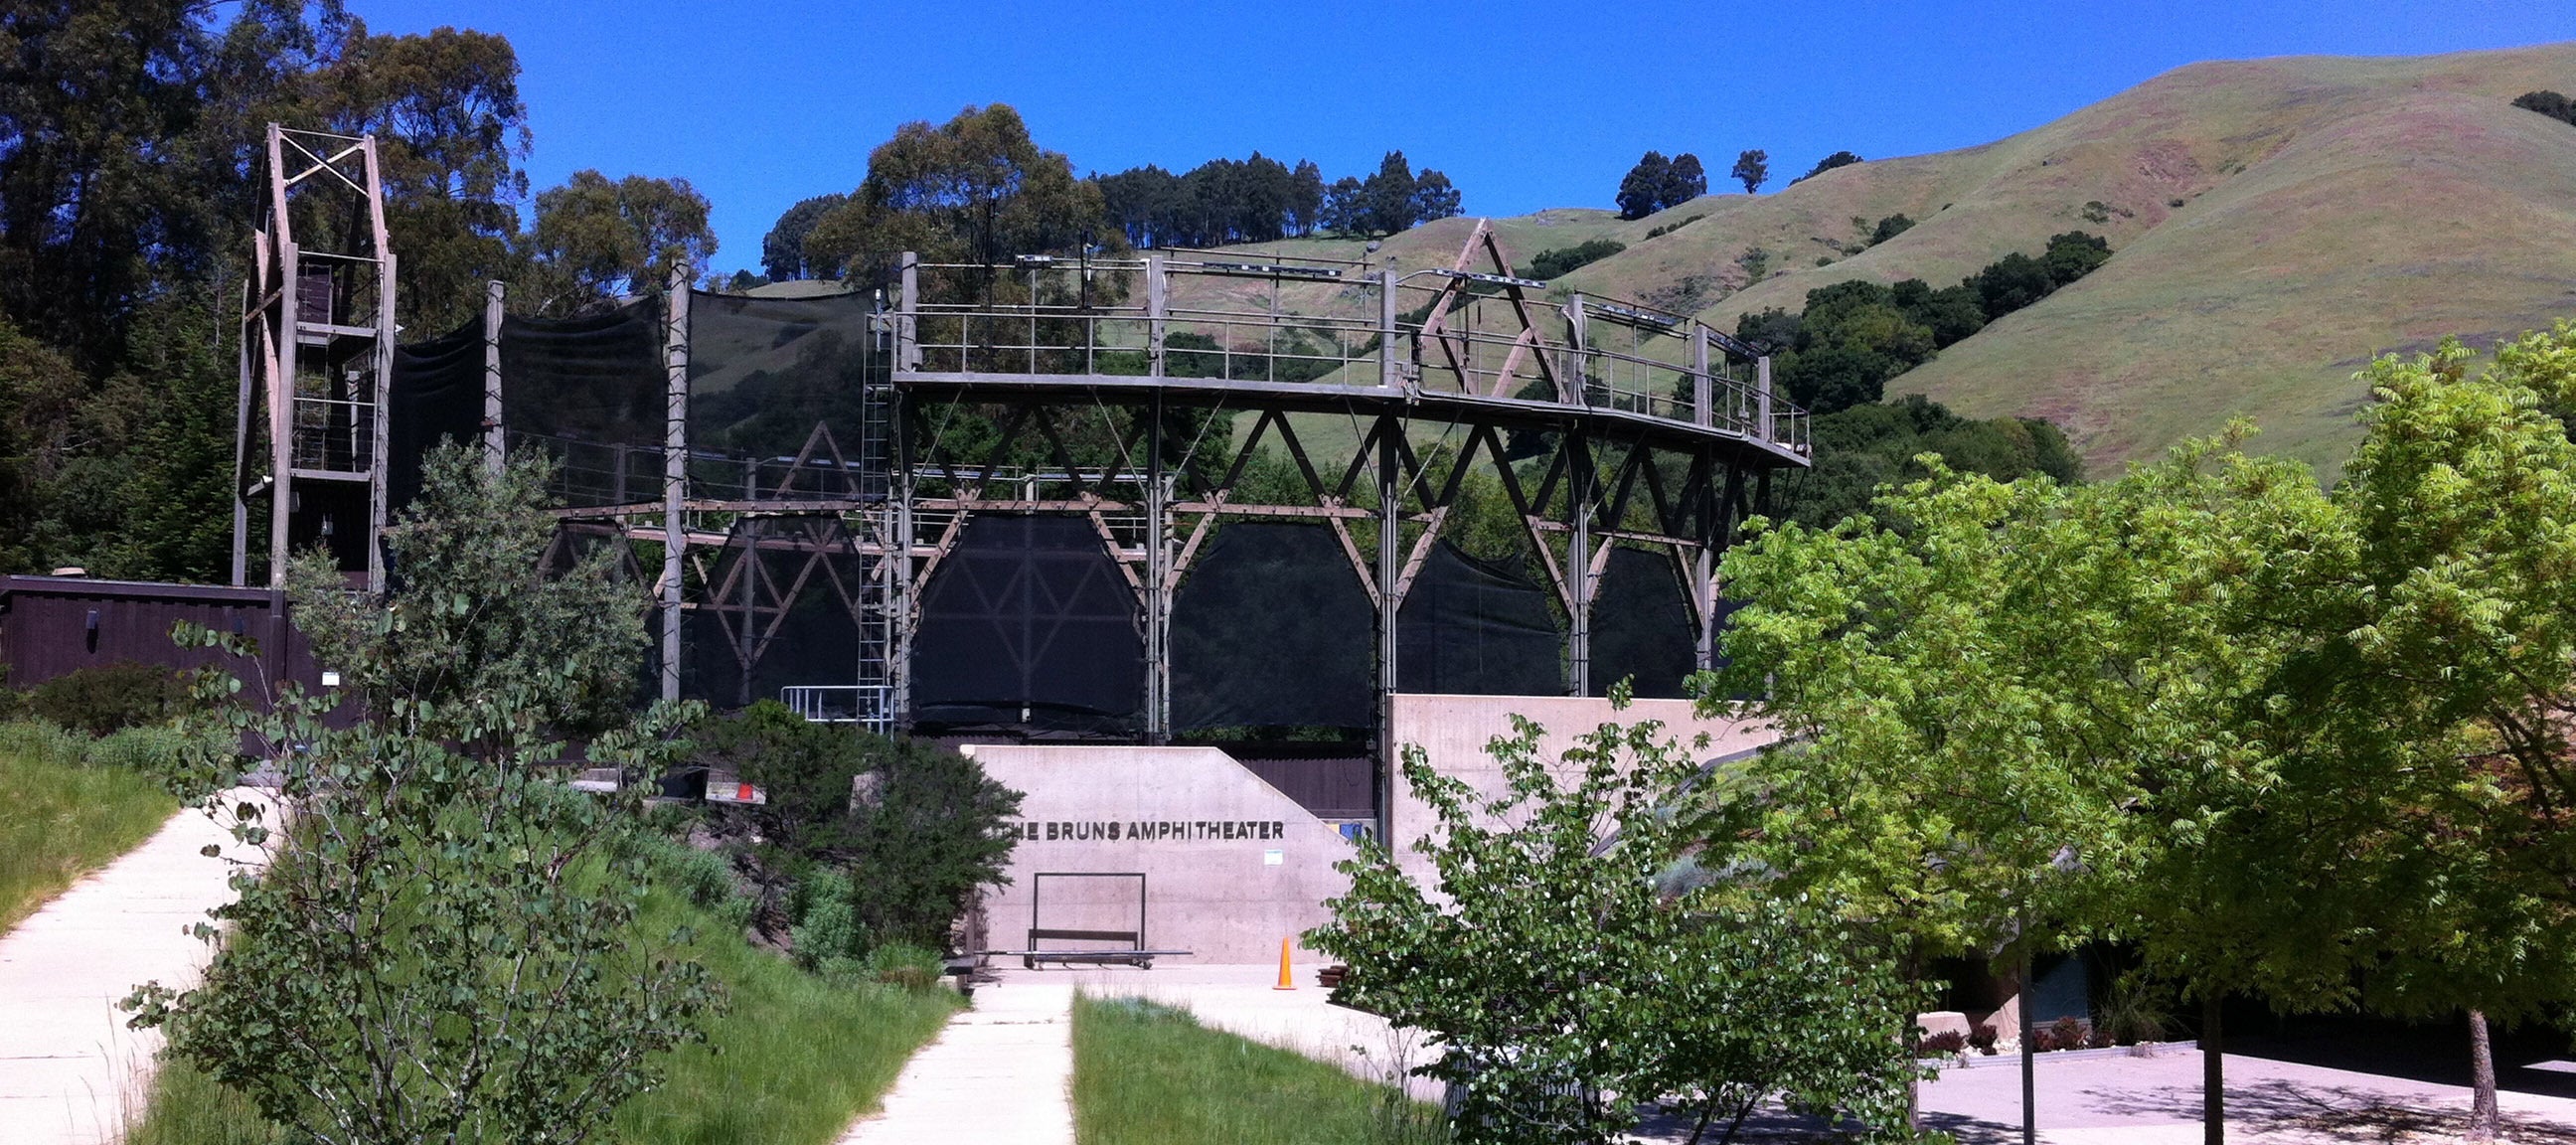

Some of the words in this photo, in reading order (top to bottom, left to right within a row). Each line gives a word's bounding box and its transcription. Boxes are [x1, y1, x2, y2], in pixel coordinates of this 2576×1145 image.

[1002, 821, 1040, 841] HE
[1046, 821, 1121, 841] BRUNS
[1126, 821, 1284, 840] AMPHITHEATER
